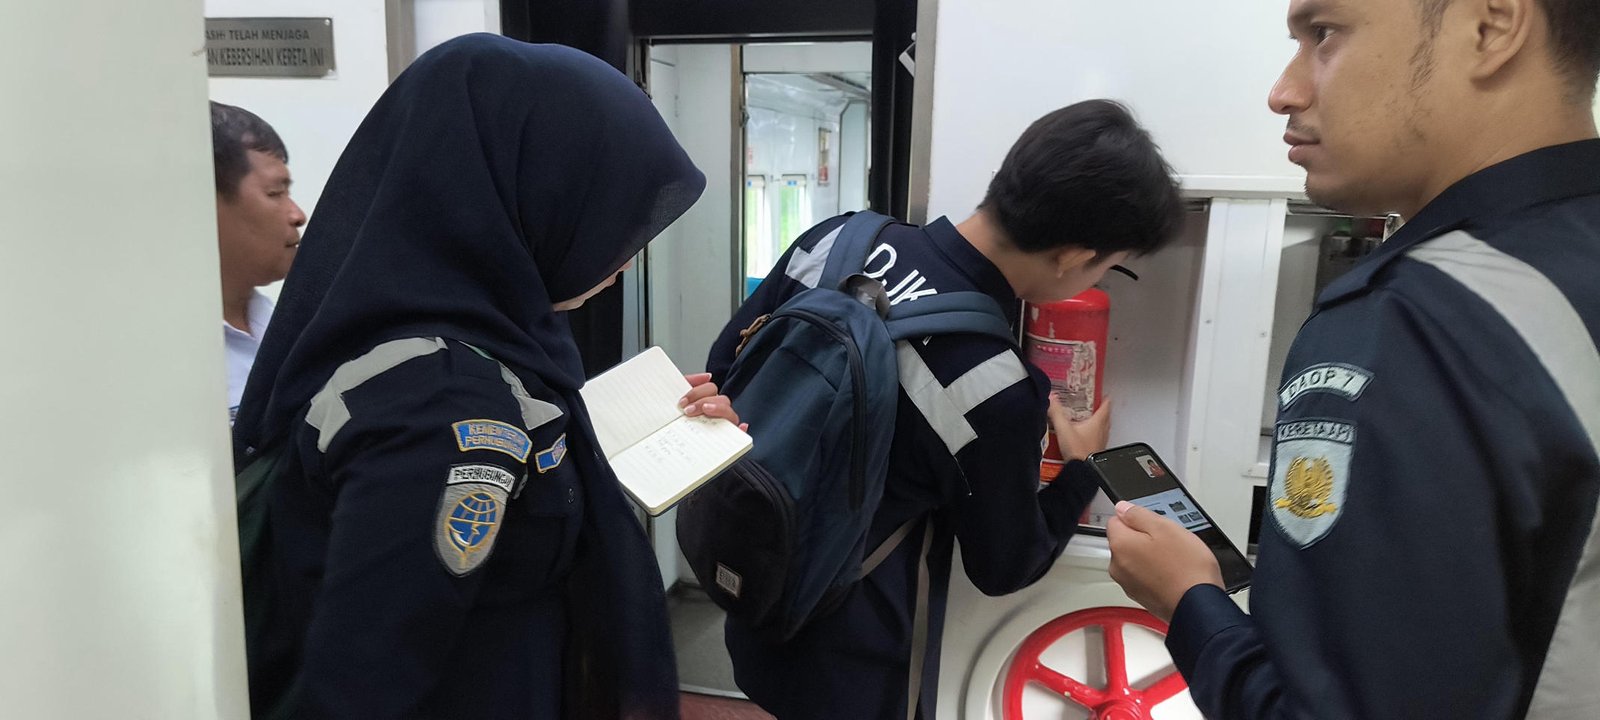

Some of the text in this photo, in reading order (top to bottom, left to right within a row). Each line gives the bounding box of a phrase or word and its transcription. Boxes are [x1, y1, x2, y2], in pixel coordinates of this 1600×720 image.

[228, 30, 259, 40] TELAH
[262, 30, 310, 40] MENJAGA
[220, 48, 274, 66] KEBERSIHAN
[276, 48, 307, 66] KERETA
[310, 48, 325, 66] INI
[1287, 369, 1355, 397] DAOP 7
